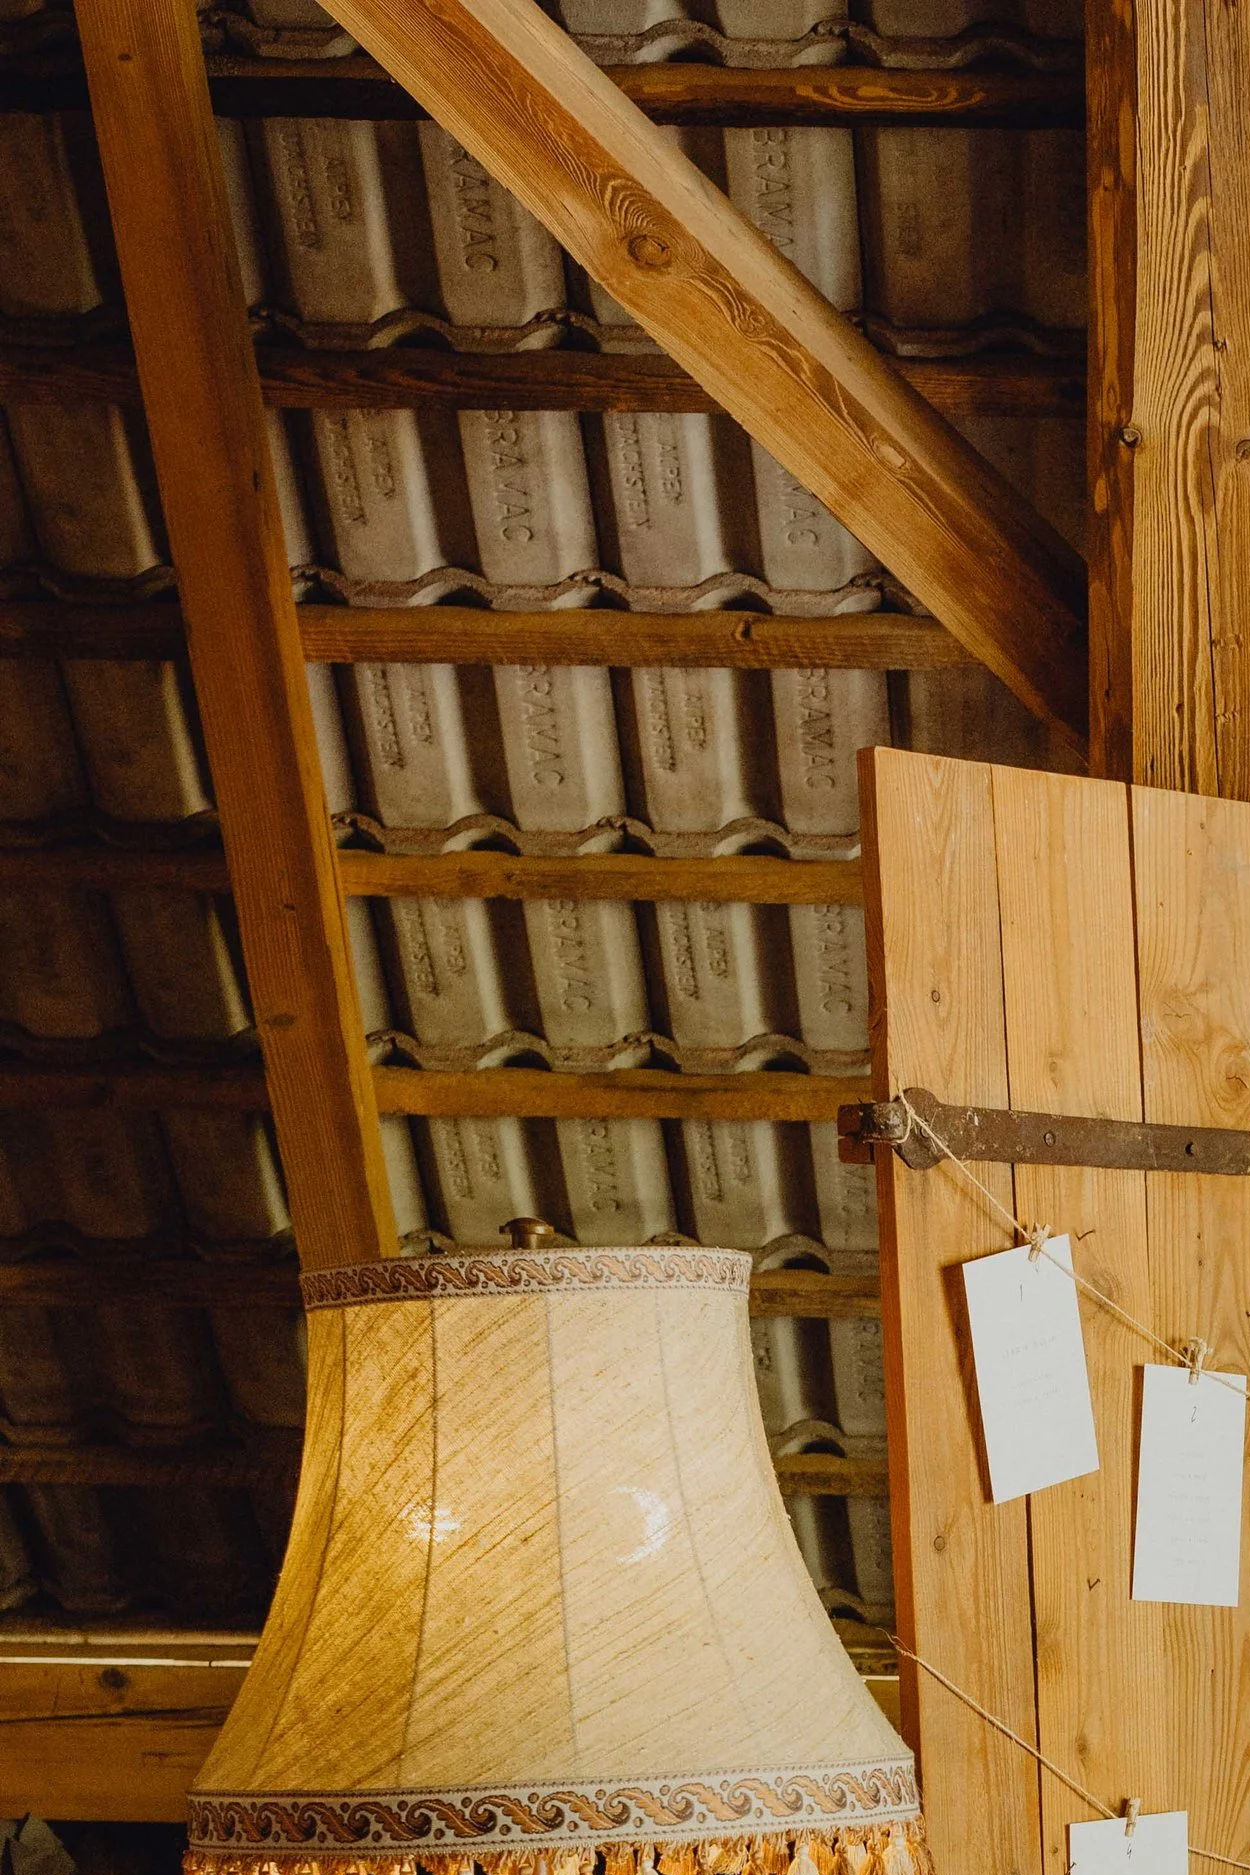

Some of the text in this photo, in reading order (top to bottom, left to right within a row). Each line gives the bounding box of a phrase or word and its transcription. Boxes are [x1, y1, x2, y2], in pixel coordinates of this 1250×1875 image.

[449, 147, 499, 274] RAMAC
[749, 127, 795, 250] BRAMA
[483, 410, 534, 545] BRAMAC
[579, 1119, 621, 1212] RAMAC
[1189, 1405, 1199, 1424] 2
[1126, 1843, 1134, 1860] 4
